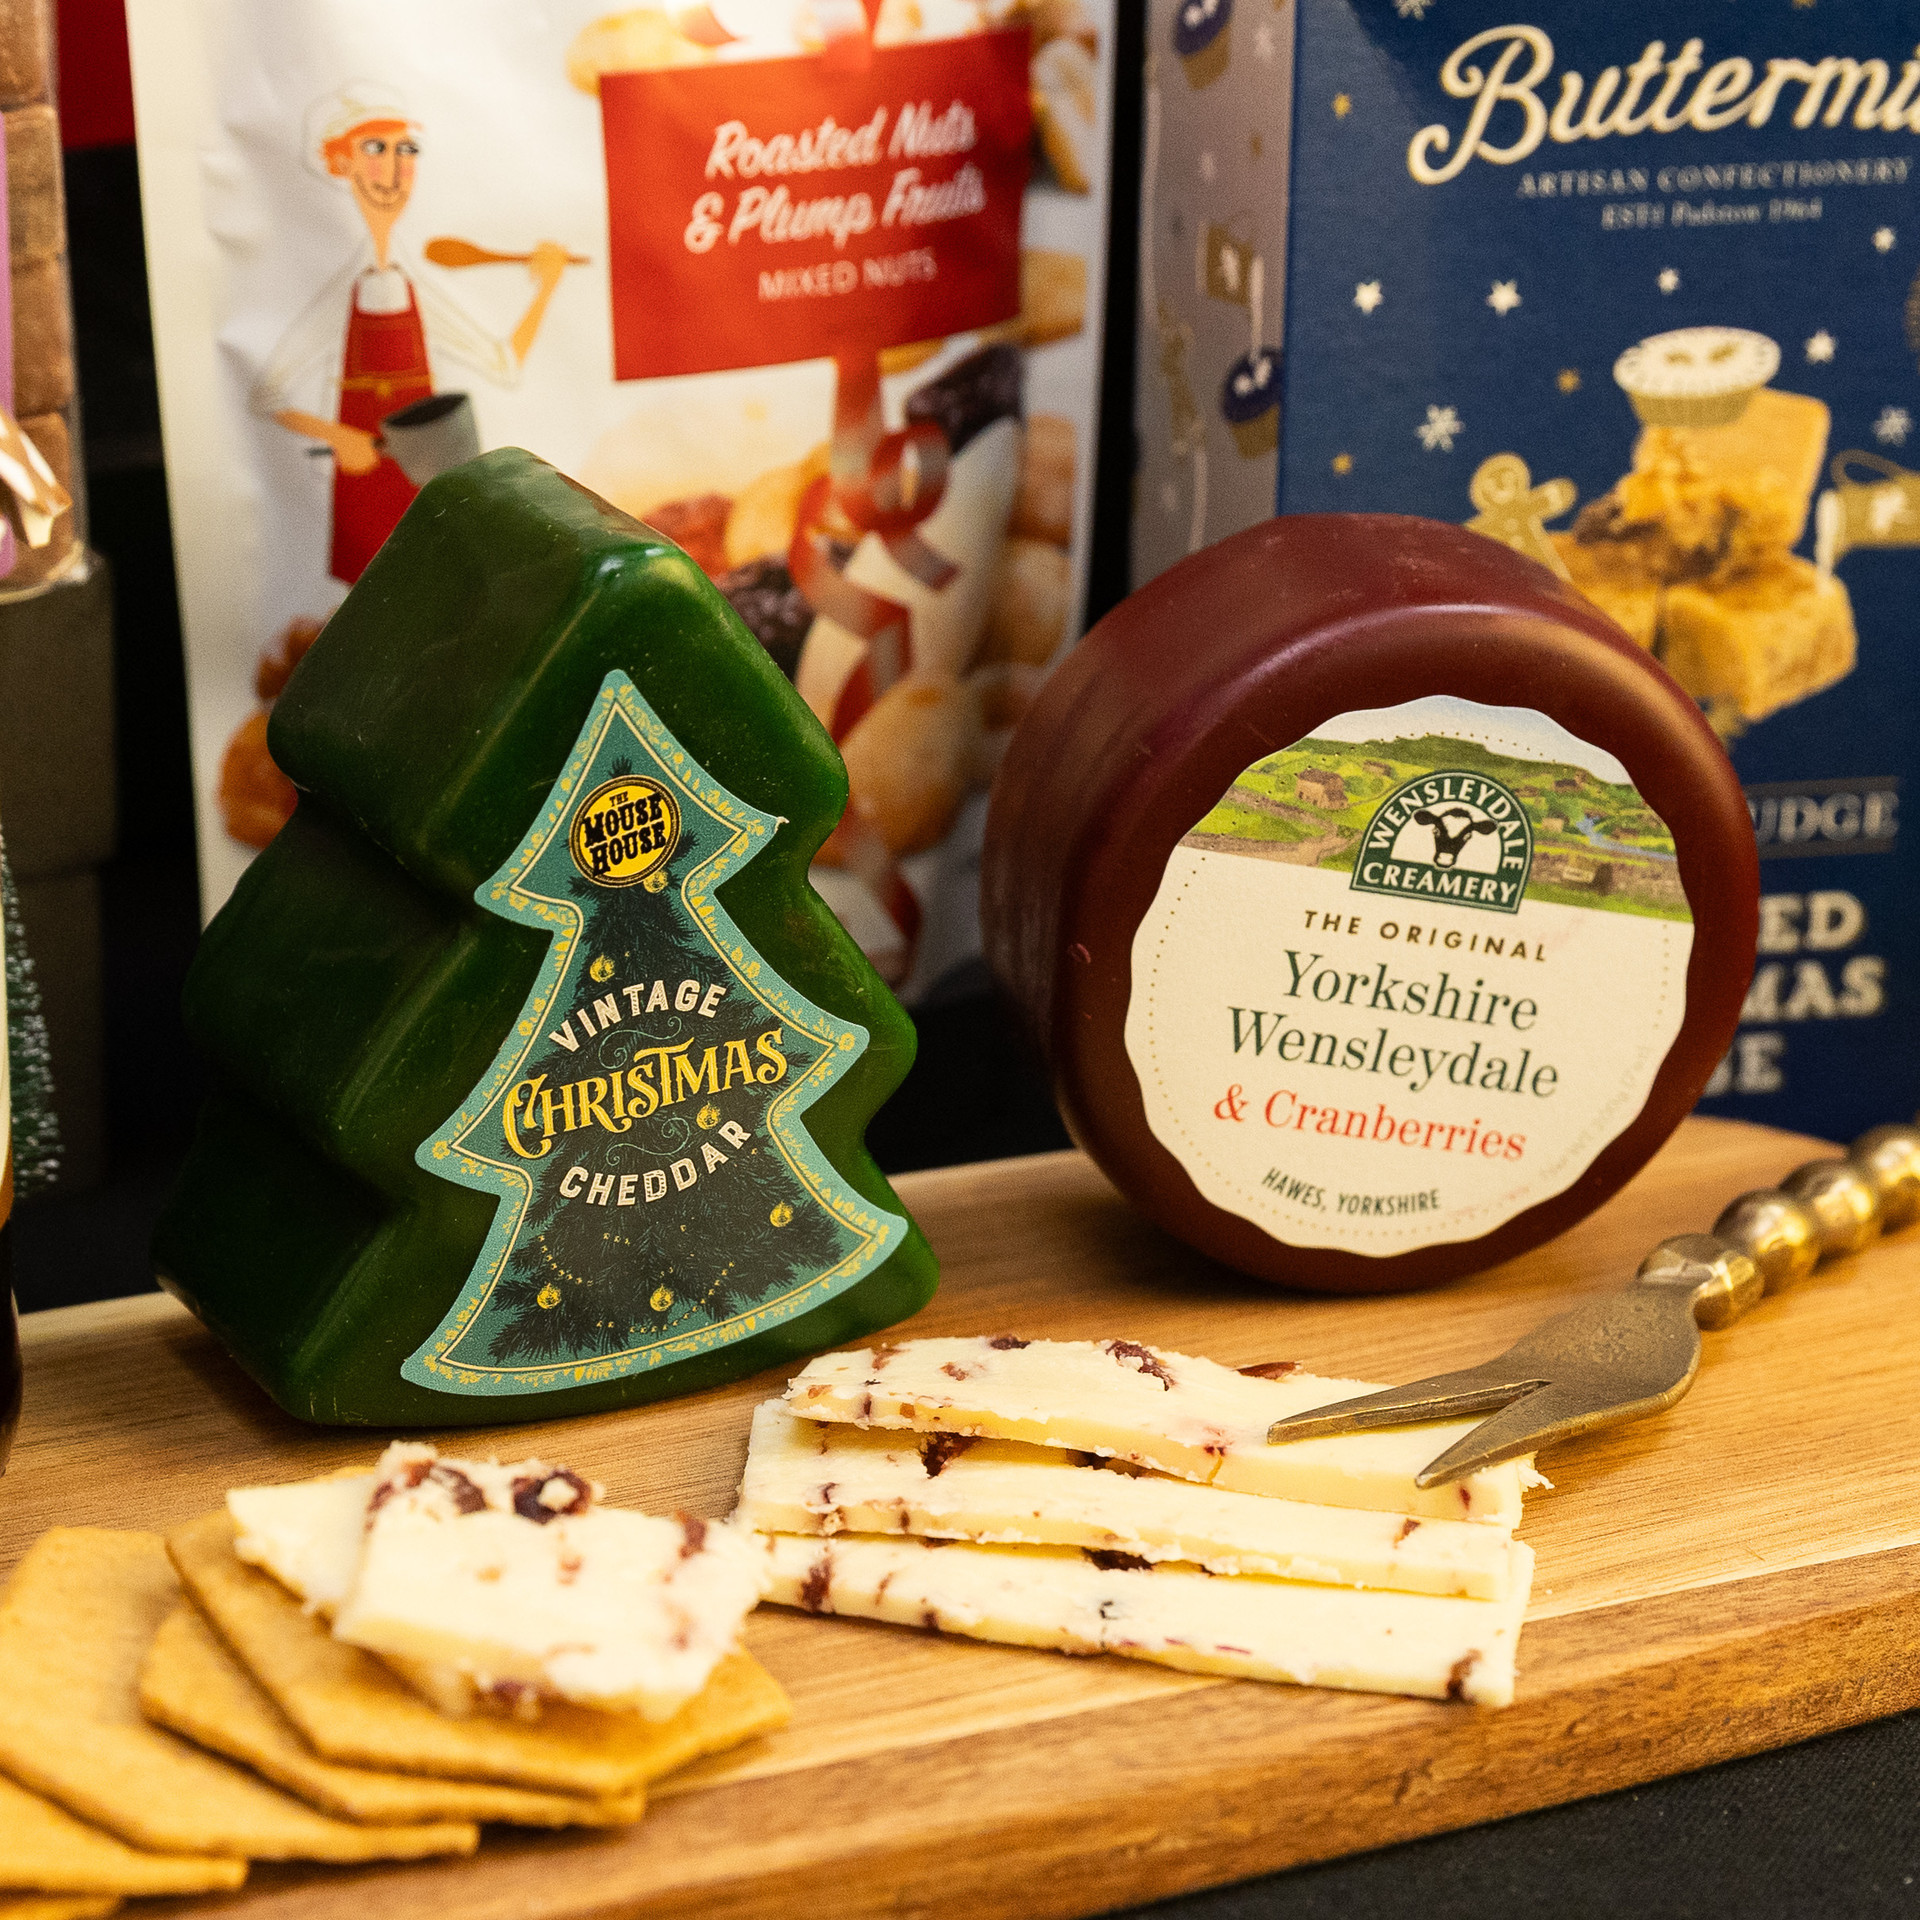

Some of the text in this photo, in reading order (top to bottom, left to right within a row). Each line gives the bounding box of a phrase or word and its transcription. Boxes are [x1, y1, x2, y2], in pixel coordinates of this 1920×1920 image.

[704, 99, 977, 180] Roasted Nuts
[1407, 24, 1920, 184] Buttermi
[684, 161, 986, 254] & Plump Fruits
[1517, 157, 1909, 198] ARTISAN CONFECTIONERY
[758, 246, 938, 301] MIXED NUTS
[582, 792, 663, 848] MOUSE
[609, 791, 628, 807] THE
[1368, 778, 1525, 870] WENSLEYDALE
[589, 821, 666, 879] HOUSE
[1362, 861, 1518, 904] CREAMERY
[1304, 911, 1547, 962] THE ORIGINAL
[549, 979, 726, 1052] VINTAGE
[1283, 948, 1539, 1032] Yorkshire
[1227, 1005, 1558, 1099] Wensleydale
[502, 1027, 787, 1160] CHRISTMAS
[1213, 1083, 1248, 1123] &
[1264, 1089, 1527, 1162] Cranberries
[559, 1120, 751, 1206] CHEDDAR
[1261, 1167, 1441, 1217] HAWES, YORKSHIRE
